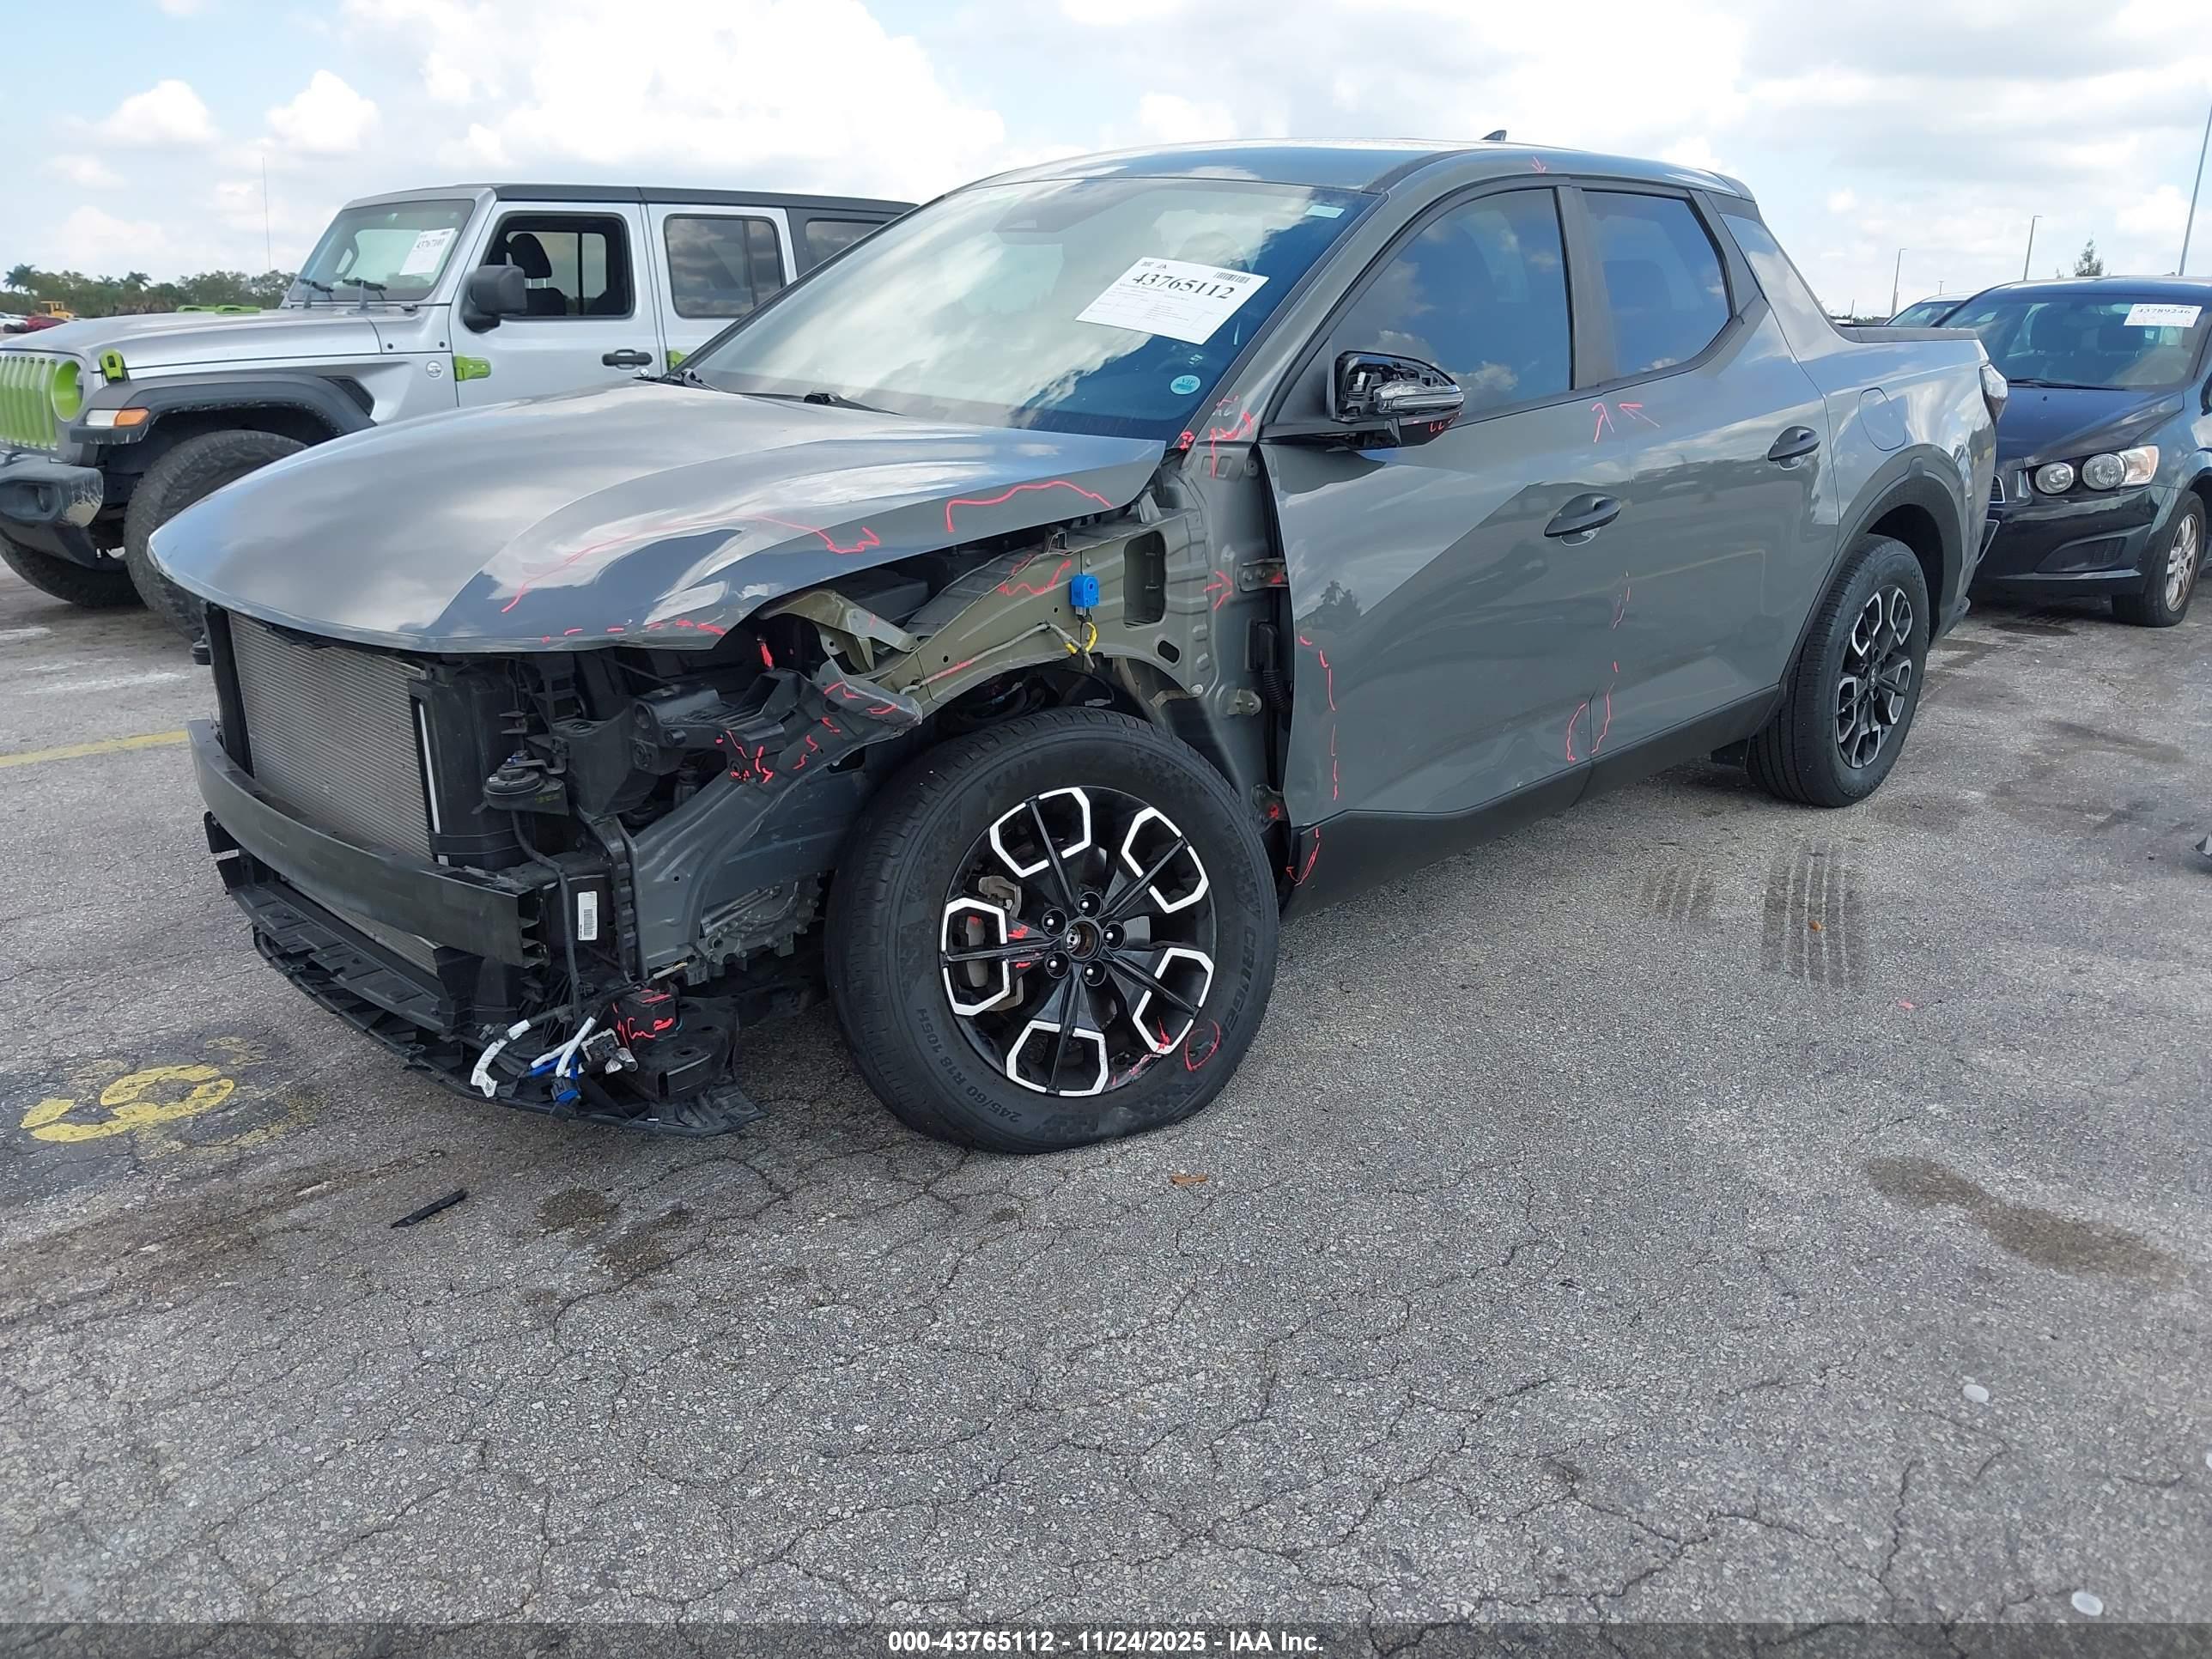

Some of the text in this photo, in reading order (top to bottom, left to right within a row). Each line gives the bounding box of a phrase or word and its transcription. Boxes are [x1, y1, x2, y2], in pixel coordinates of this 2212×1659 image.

[1133, 273, 1236, 299] 43765112
[915, 1008, 1023, 1123] 245/60 R18 105H
